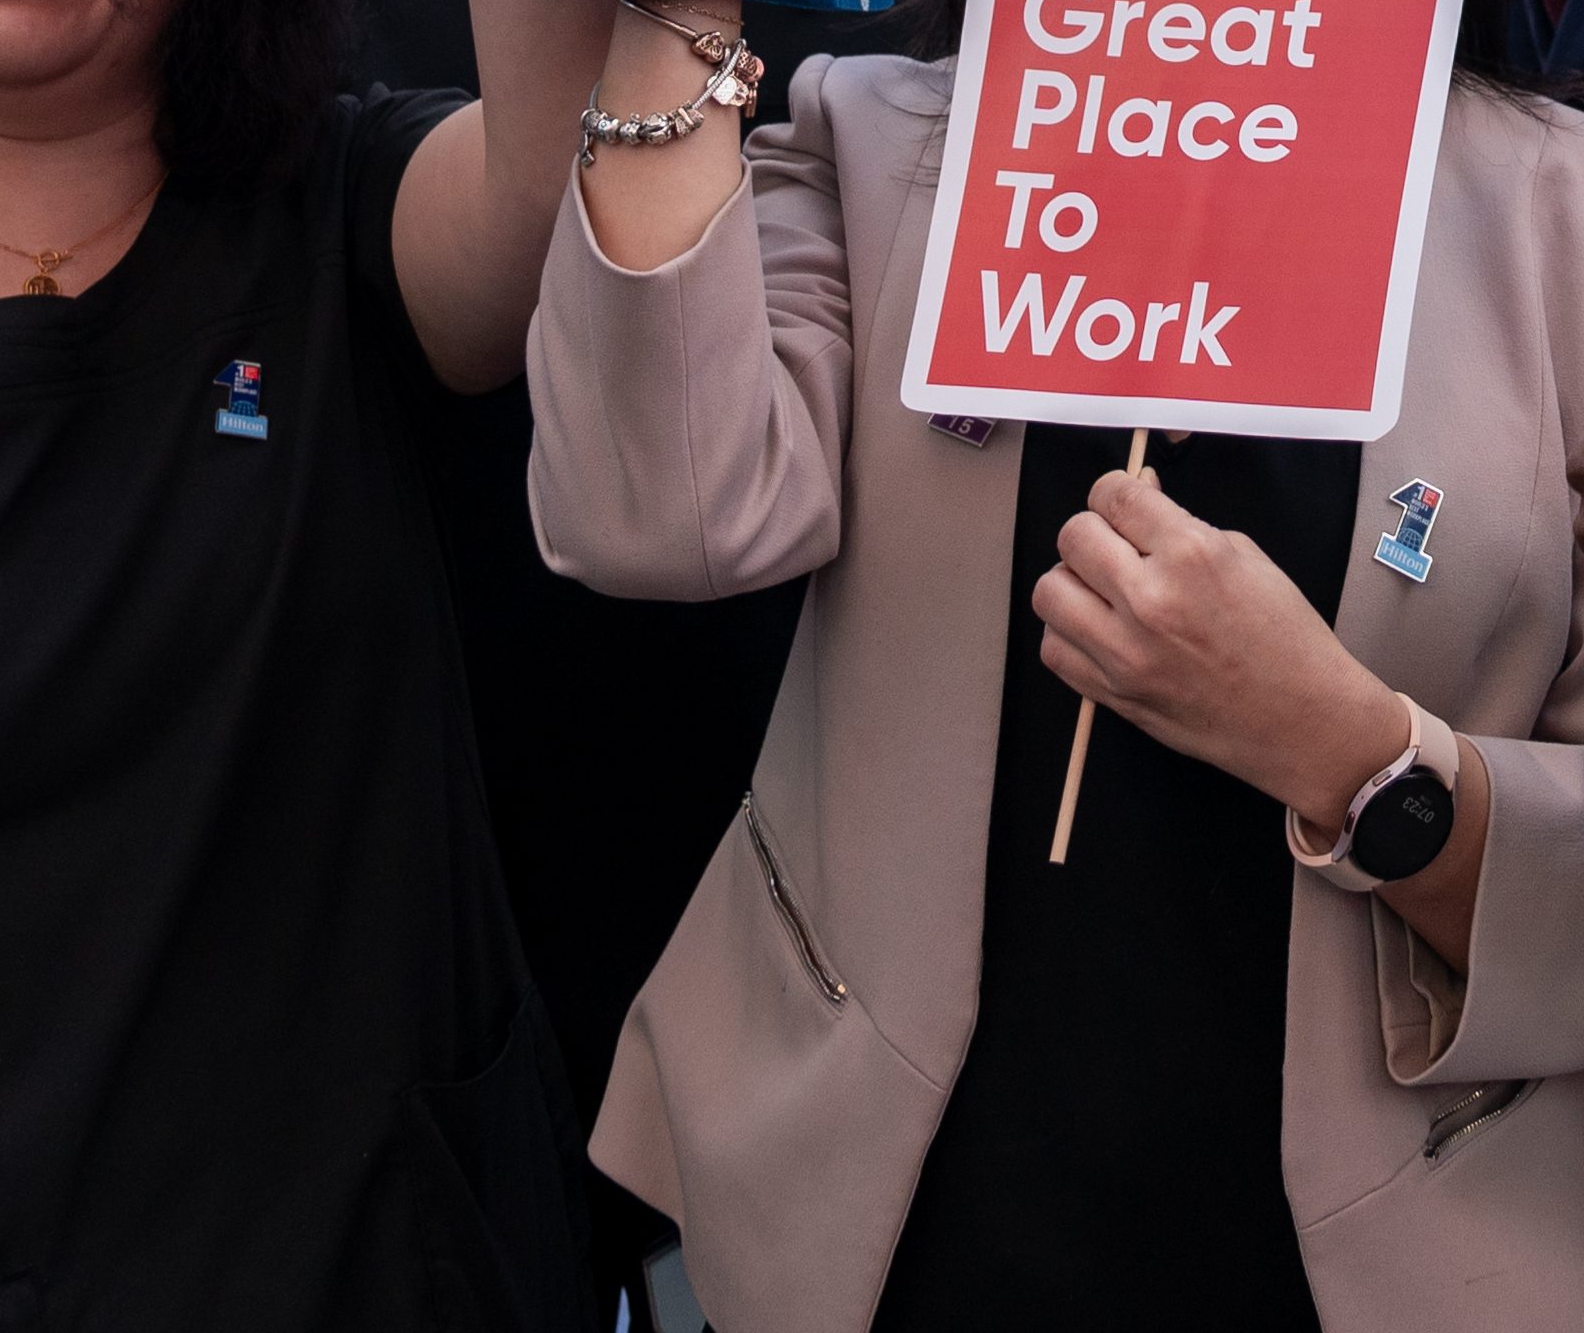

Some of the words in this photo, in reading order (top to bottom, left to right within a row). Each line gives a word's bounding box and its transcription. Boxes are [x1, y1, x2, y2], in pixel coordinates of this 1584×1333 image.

[1011, 69, 1299, 163] Place
[995, 169, 1099, 253] To
[980, 269, 1241, 367] Work
[222, 416, 264, 433] Hilton
[1382, 542, 1425, 574] Hilton
[1402, 796, 1435, 823] 07:23
